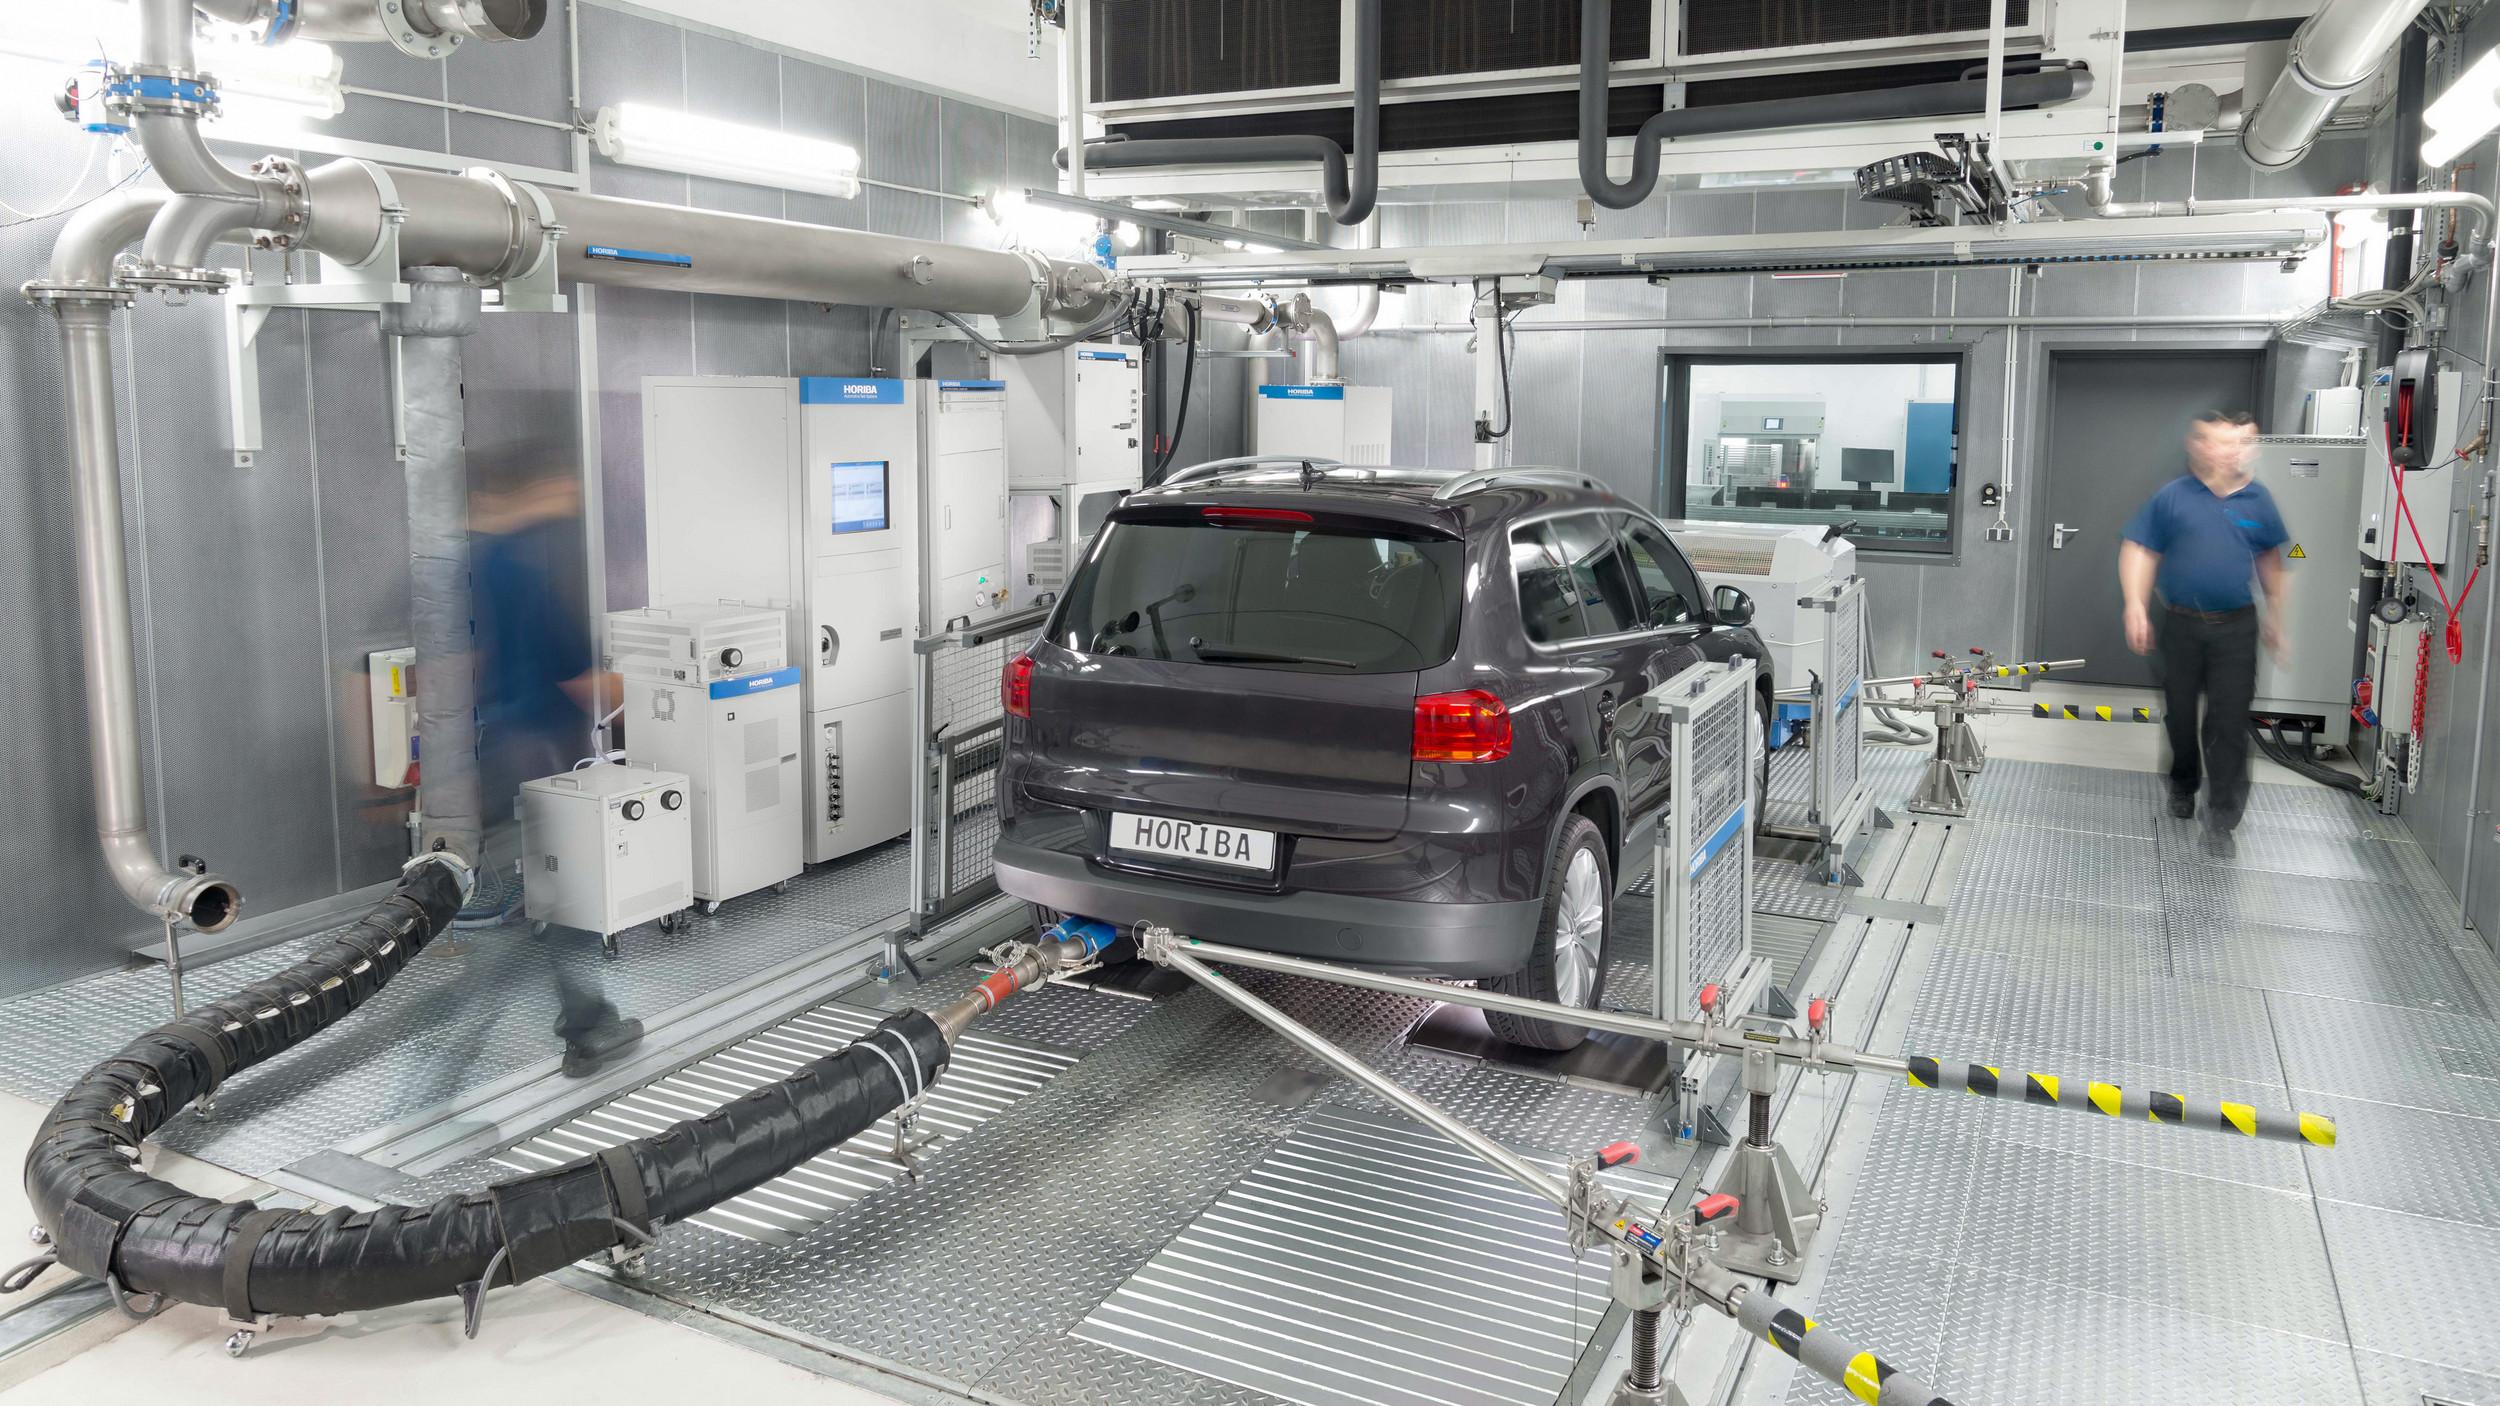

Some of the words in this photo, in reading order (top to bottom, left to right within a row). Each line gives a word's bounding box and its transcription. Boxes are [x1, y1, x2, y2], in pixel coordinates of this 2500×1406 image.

[592, 247, 618, 256] HORIBA
[843, 385, 877, 394] HORIBA
[749, 677, 773, 687] HORIBA
[1135, 817, 1250, 862] HORIBA
